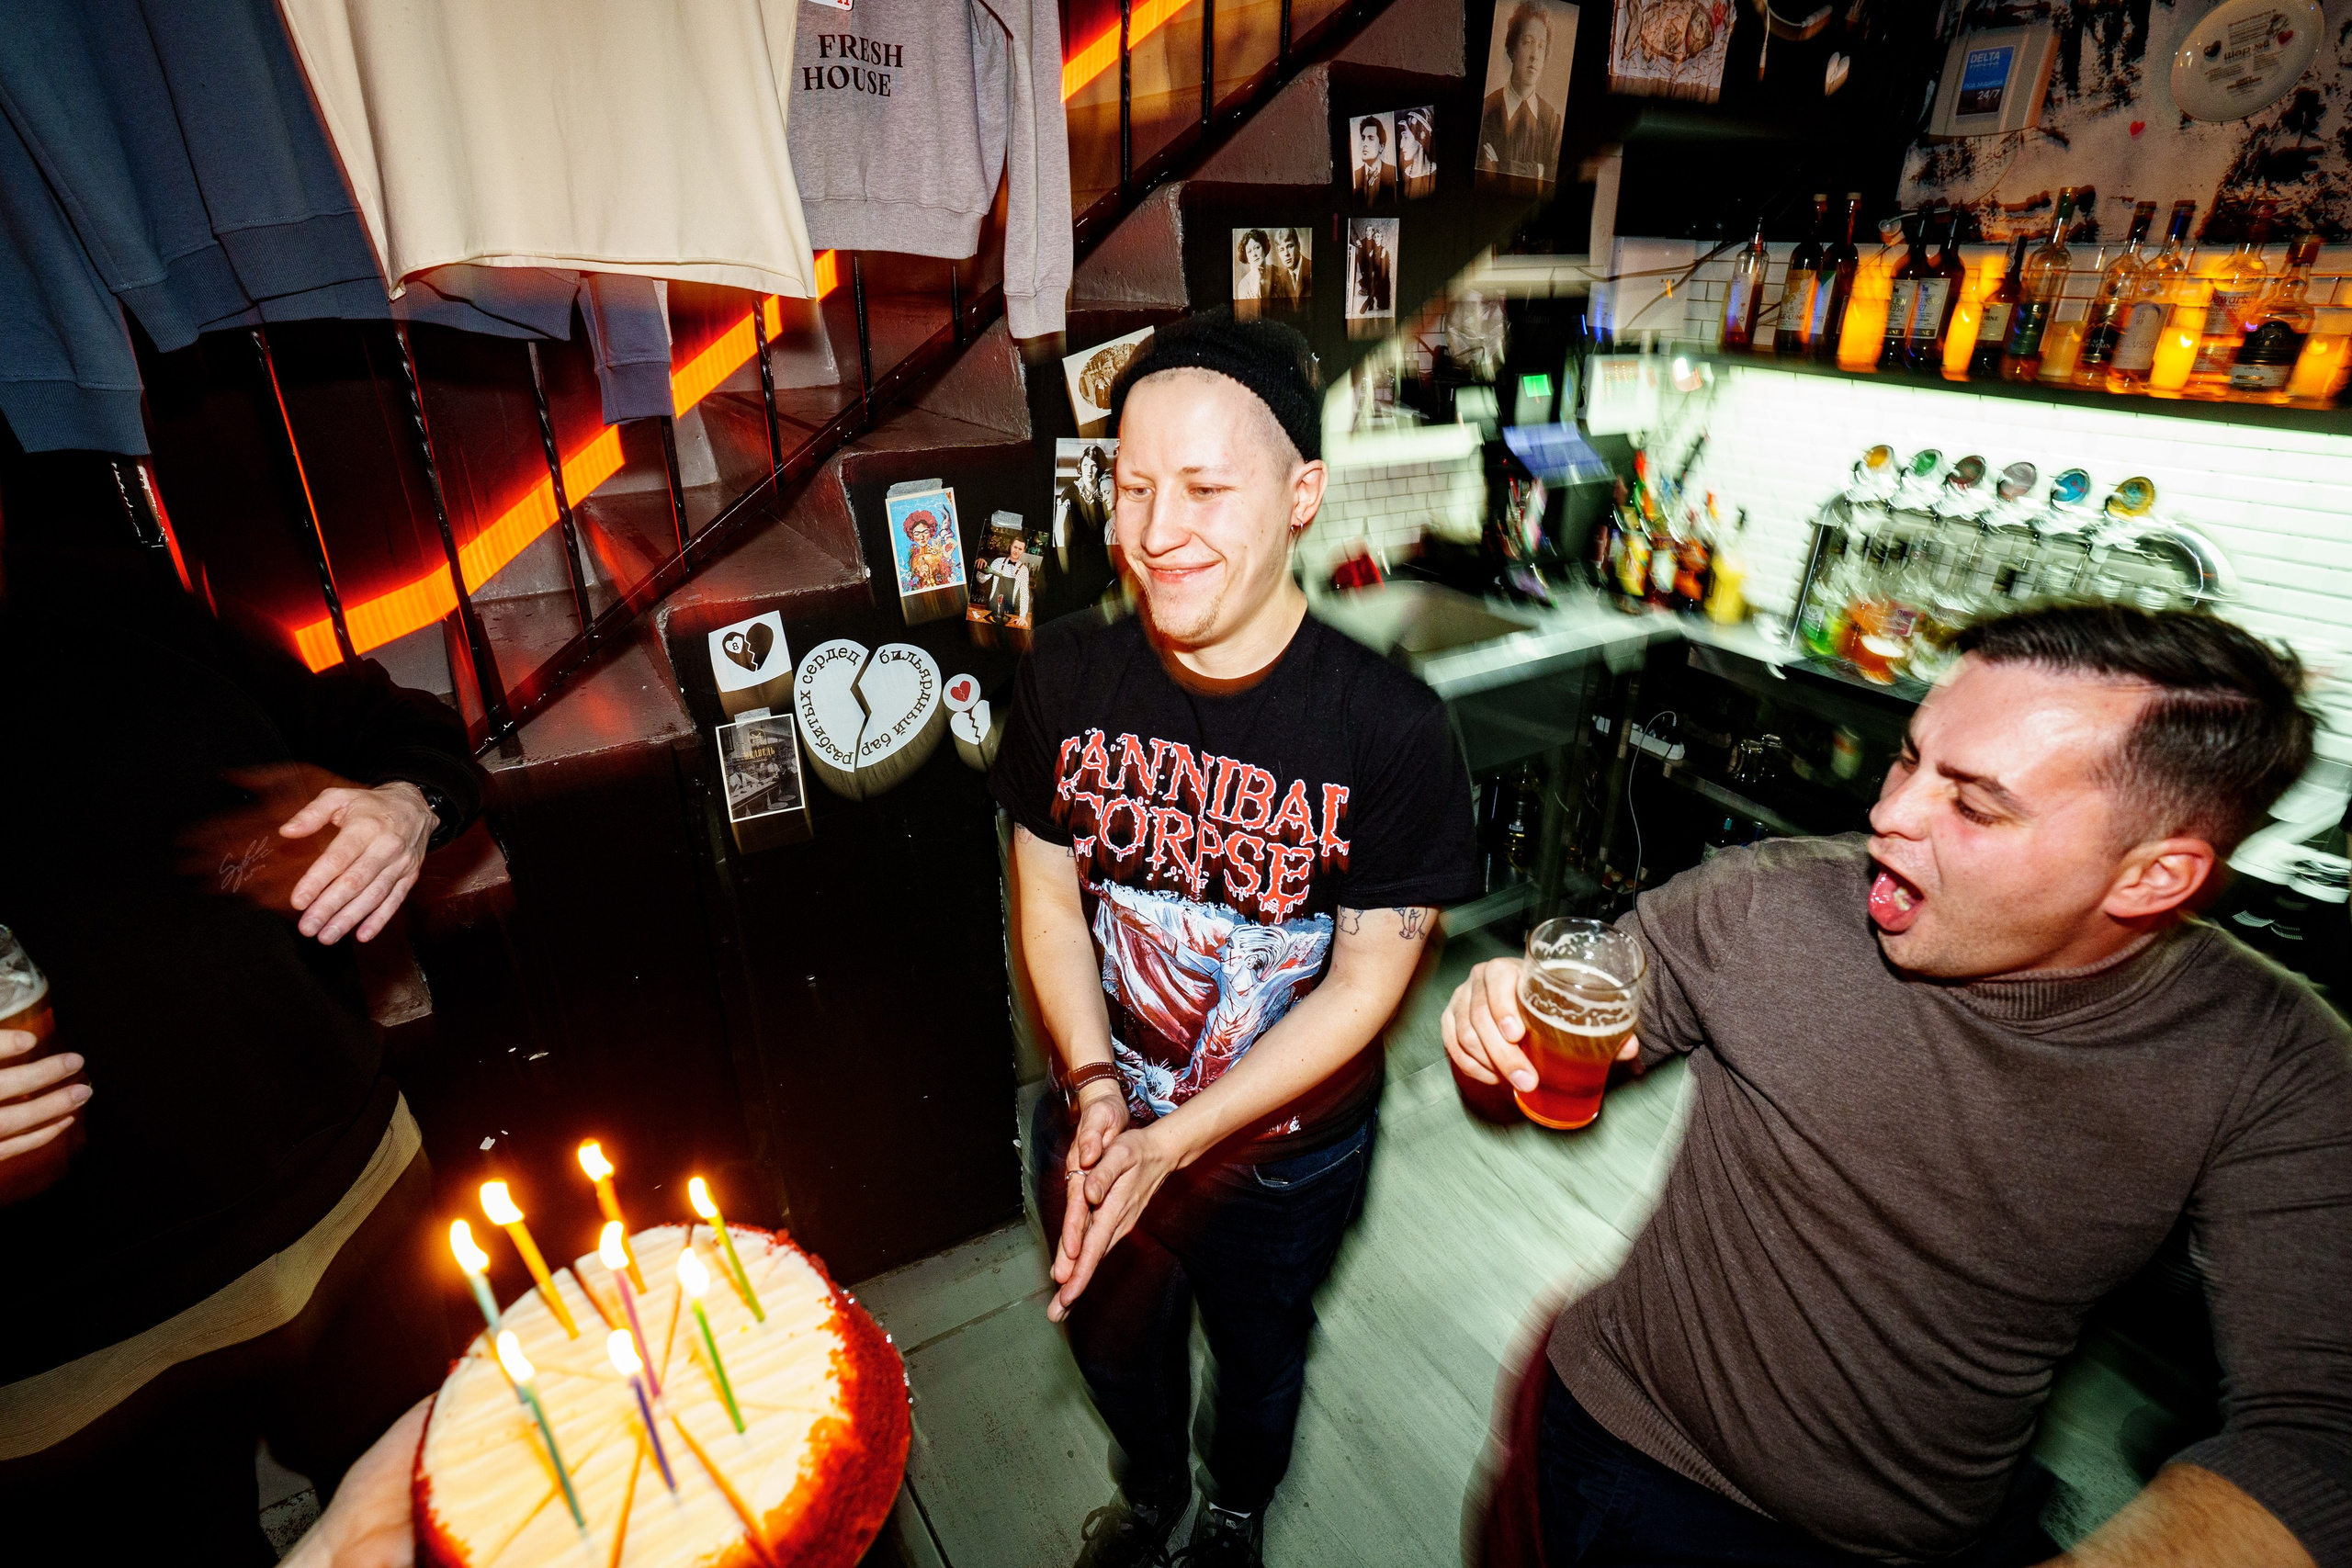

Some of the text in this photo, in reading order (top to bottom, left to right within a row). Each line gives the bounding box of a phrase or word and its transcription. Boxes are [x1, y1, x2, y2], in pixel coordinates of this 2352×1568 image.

[818, 34, 904, 68] FRESH
[1971, 51, 2000, 63] DELTA
[802, 65, 891, 97] HOUSE
[1977, 89, 2000, 100] 24/7
[732, 642, 740, 651] 8
[861, 649, 933, 756] бильярдный бар
[799, 690, 854, 765] разбитых
